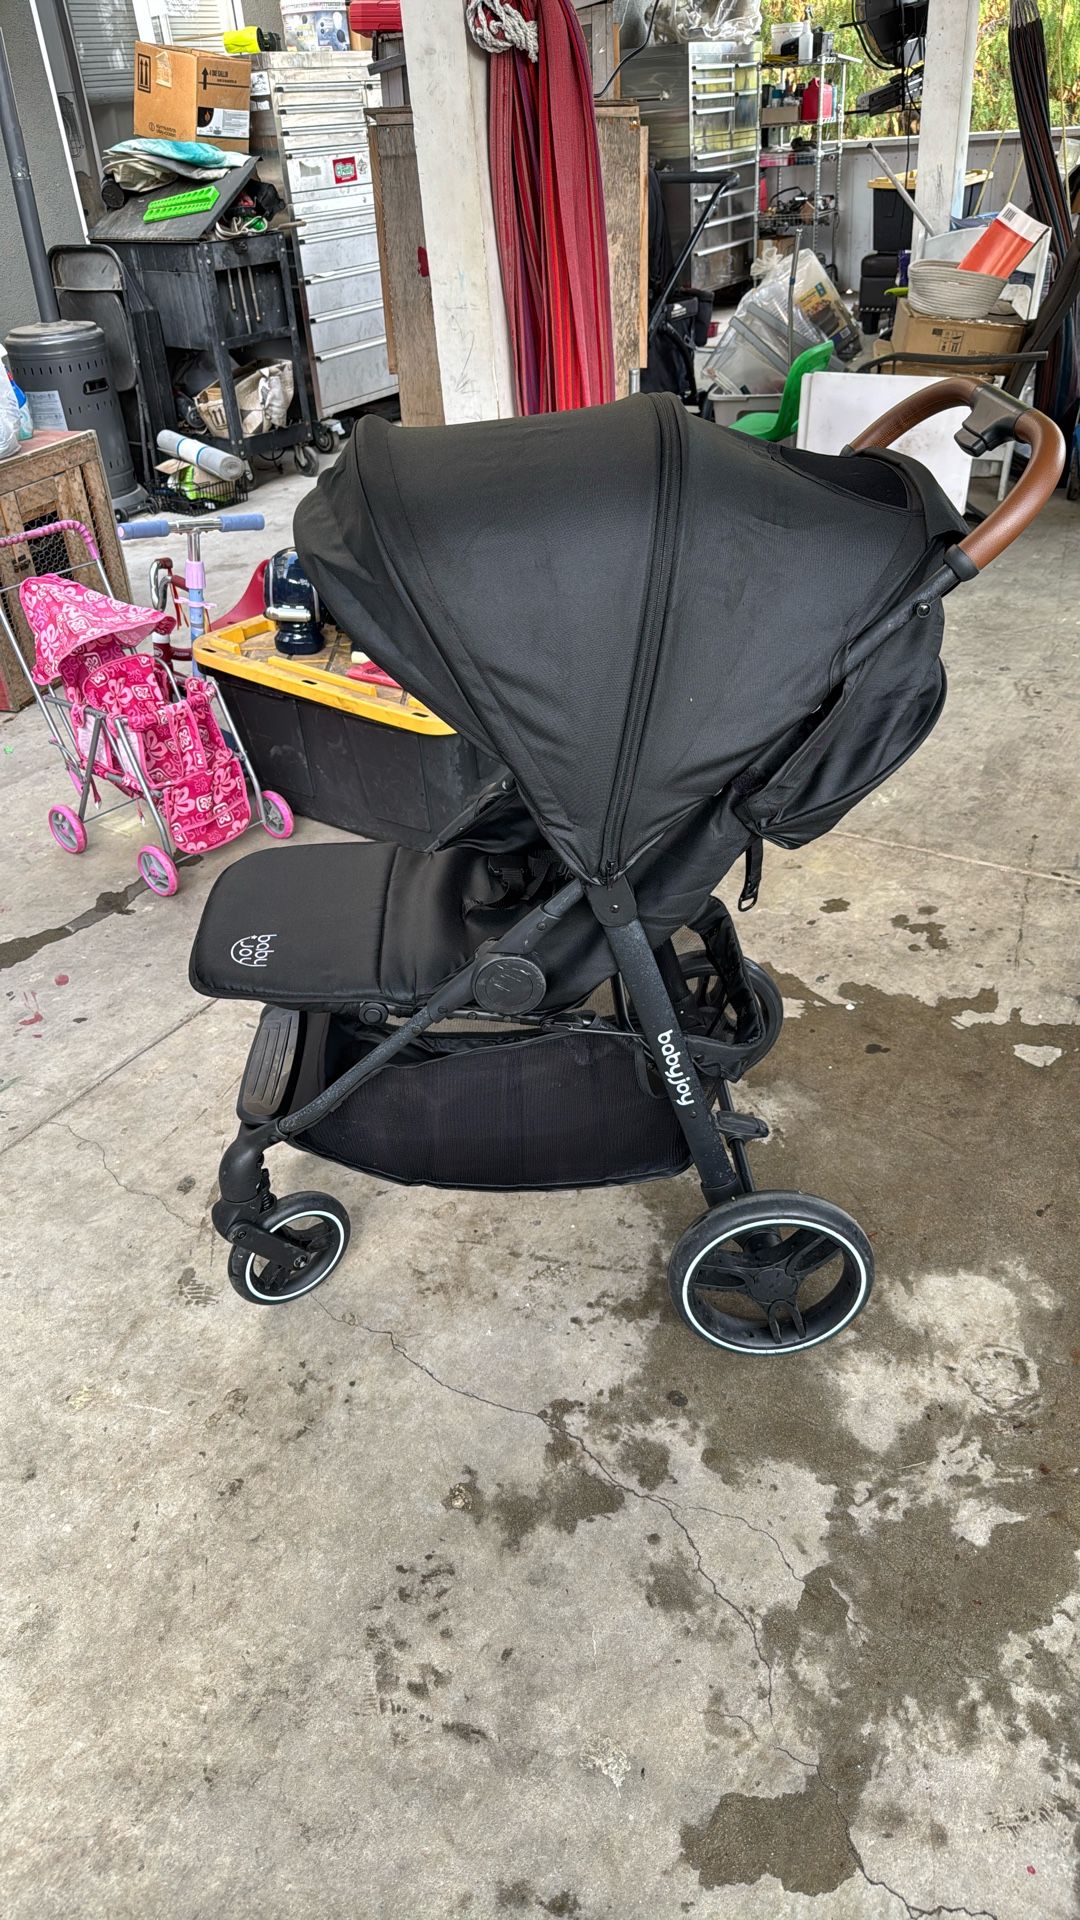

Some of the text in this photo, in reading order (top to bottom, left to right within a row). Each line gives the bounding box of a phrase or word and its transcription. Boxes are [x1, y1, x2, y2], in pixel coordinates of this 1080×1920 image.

[236, 936, 255, 966] joy
[254, 934, 277, 967] baby
[658, 1029, 695, 1106] babyjoy
